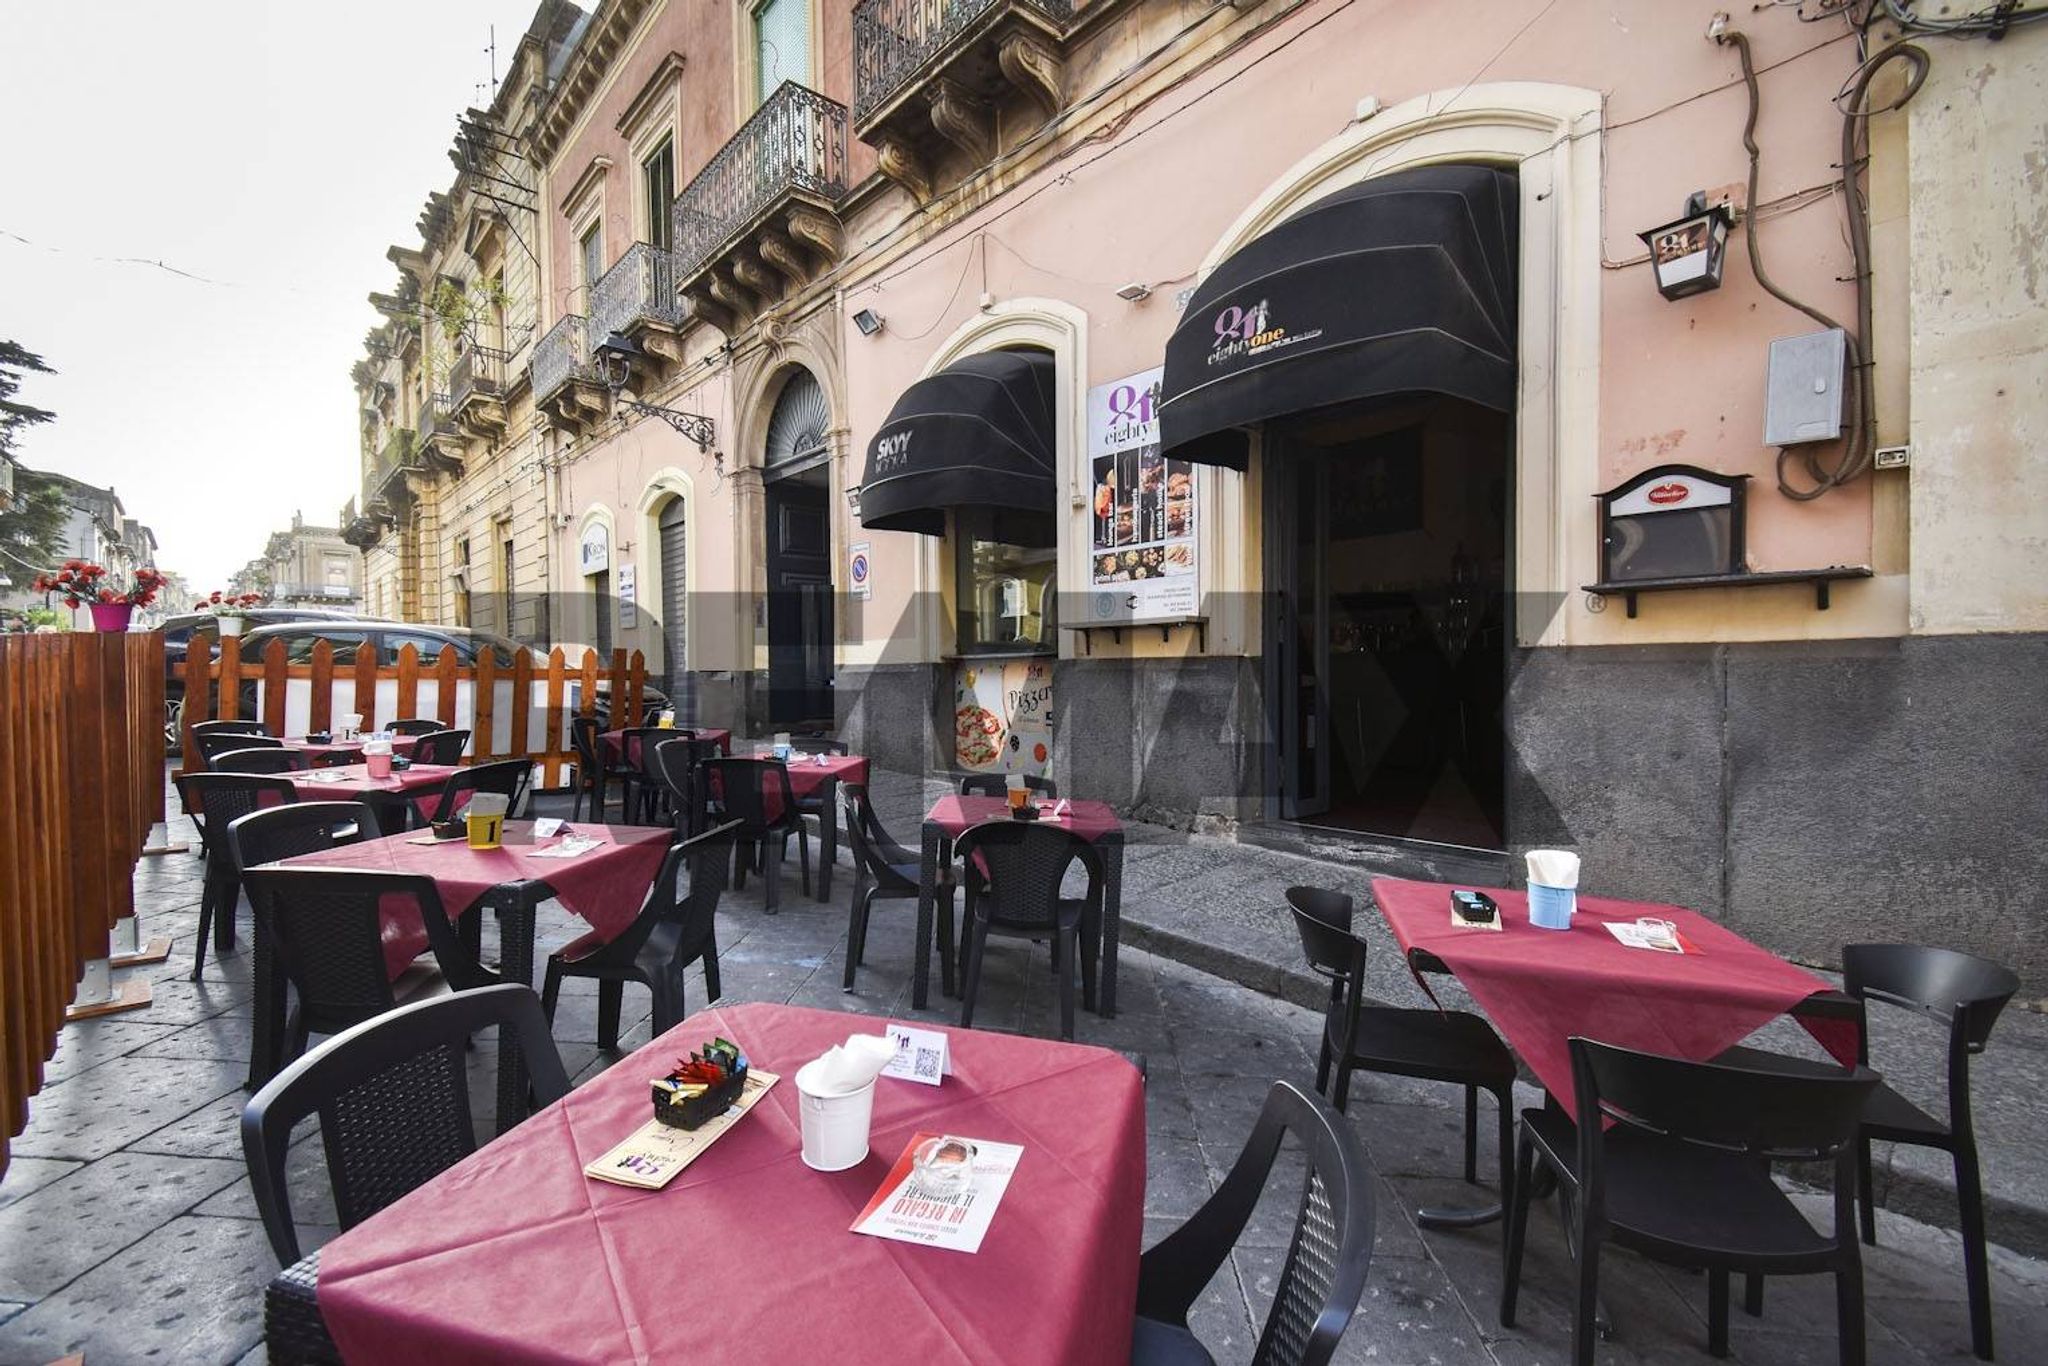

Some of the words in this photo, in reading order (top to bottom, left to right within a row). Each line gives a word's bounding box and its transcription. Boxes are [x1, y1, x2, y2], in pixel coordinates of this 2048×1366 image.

[1108, 385, 1151, 426] 81
[876, 429, 914, 461] SKYY
[890, 1197, 948, 1221] REGALO
